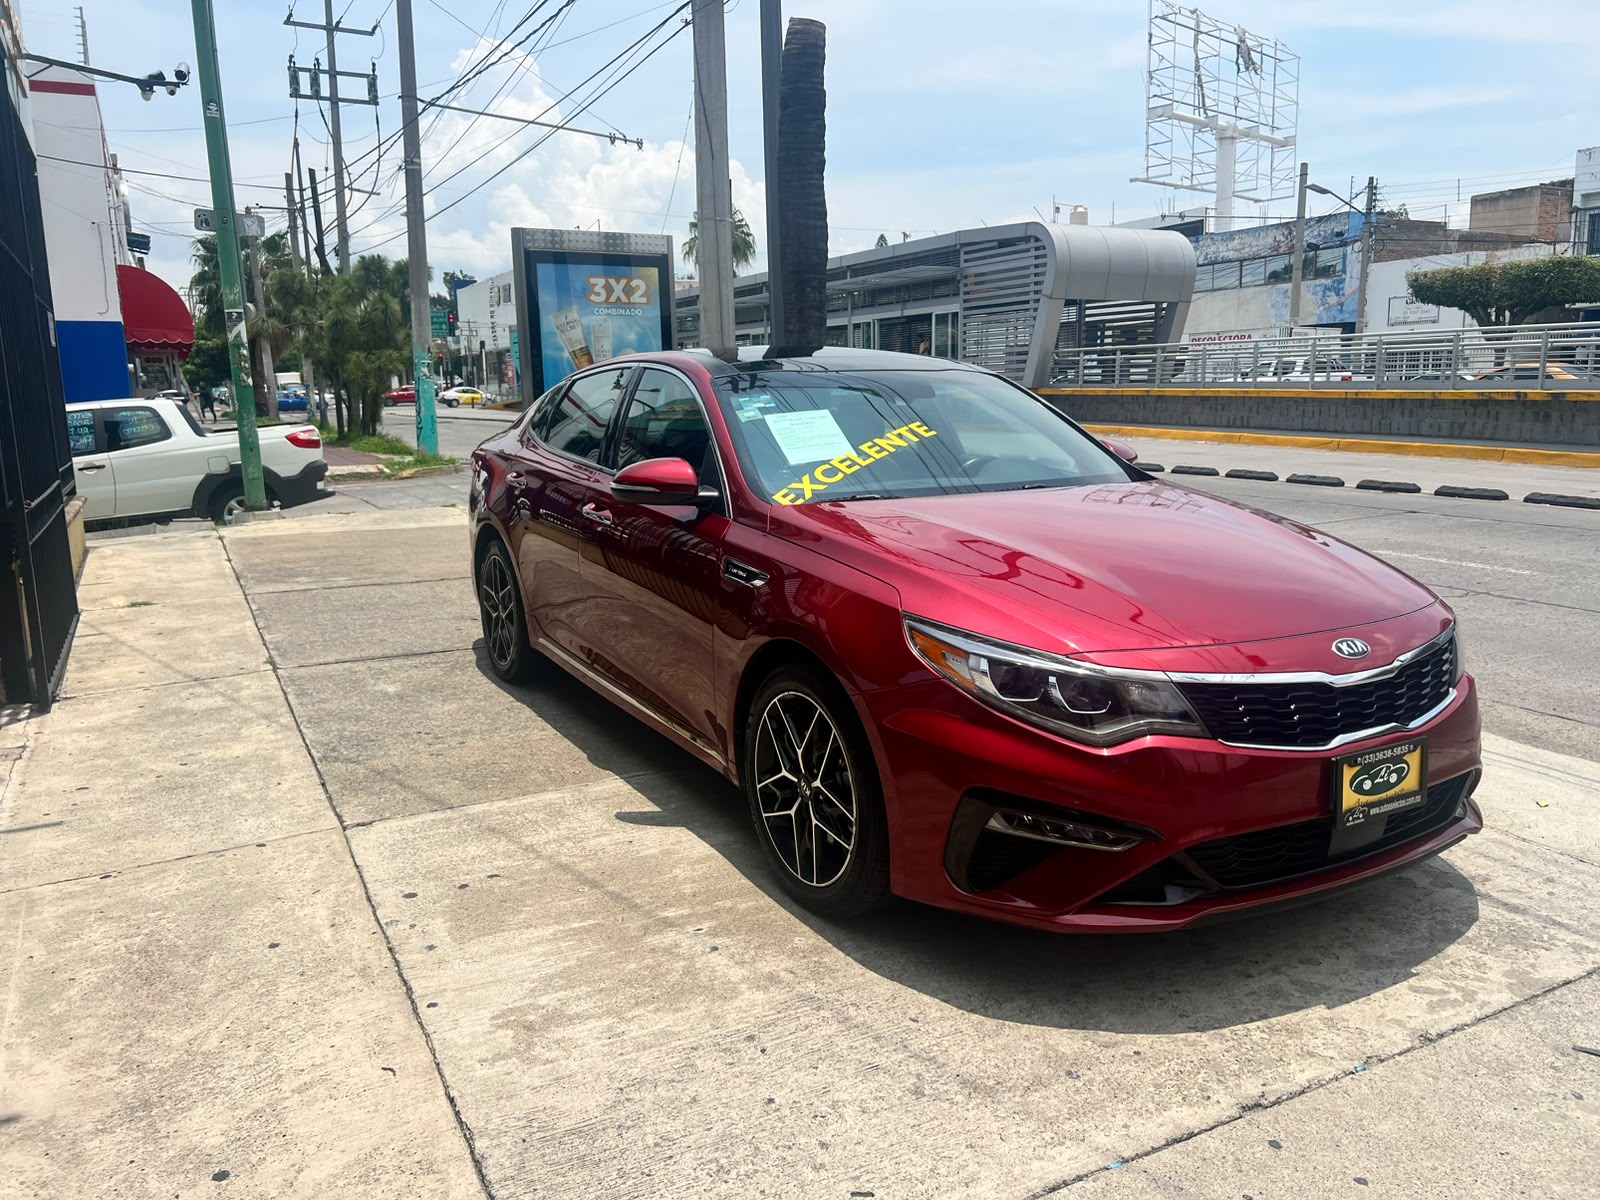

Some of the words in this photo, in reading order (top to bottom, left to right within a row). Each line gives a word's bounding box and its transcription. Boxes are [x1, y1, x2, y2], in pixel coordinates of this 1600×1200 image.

[589, 277, 647, 303] 3X2
[593, 307, 643, 316] COMBINADO
[772, 421, 938, 506] EXCELENTE
[1336, 640, 1368, 655] KIA
